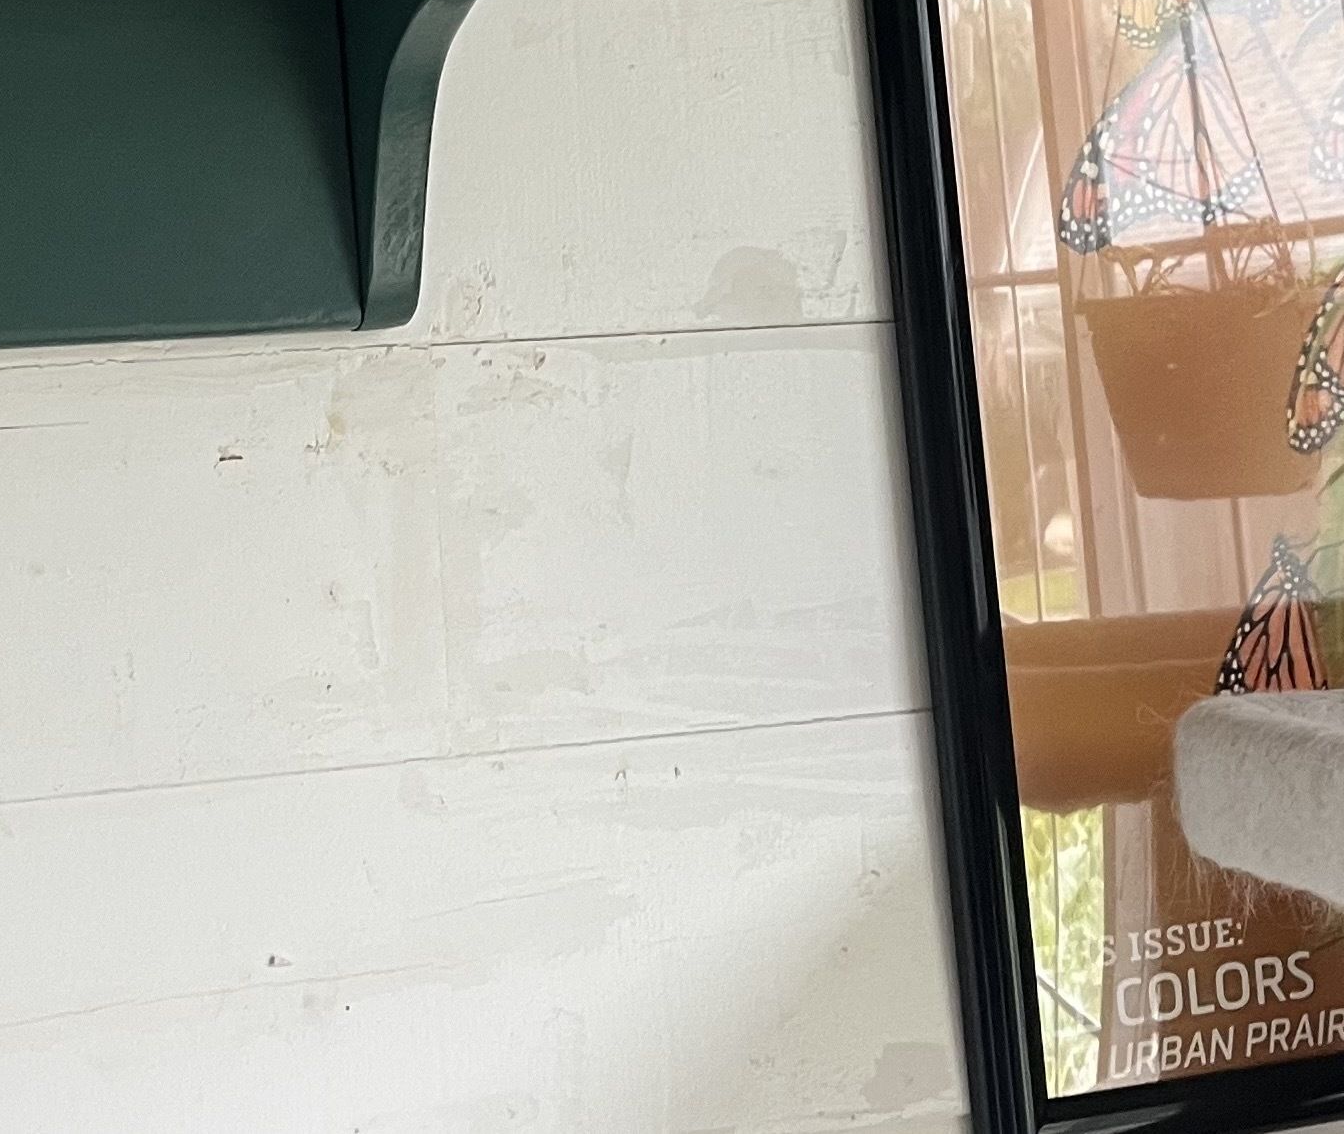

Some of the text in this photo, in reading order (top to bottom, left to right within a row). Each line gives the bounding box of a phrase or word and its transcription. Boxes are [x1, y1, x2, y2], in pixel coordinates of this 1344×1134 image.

[1127, 918, 1244, 962] ISSUE:
[1115, 950, 1315, 1027] COLORS
[1109, 1025, 1235, 1079] URBAN
